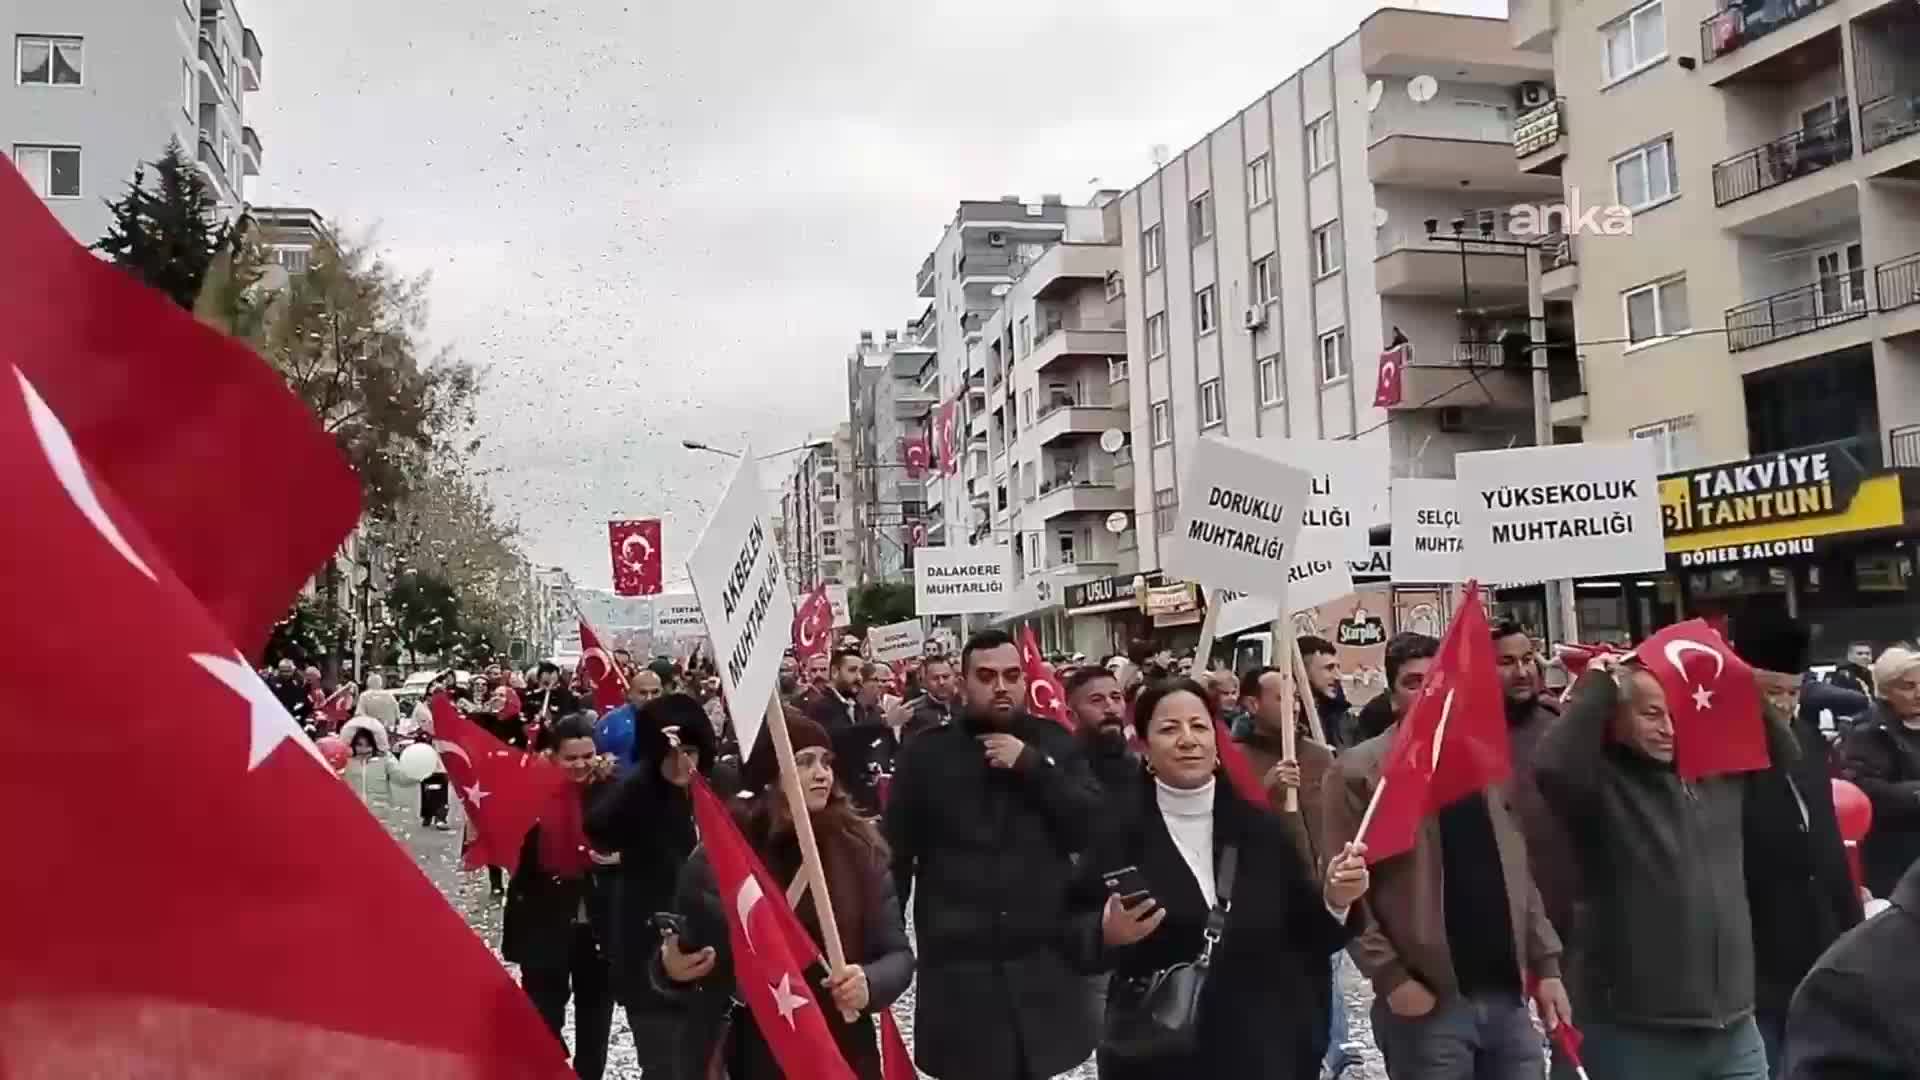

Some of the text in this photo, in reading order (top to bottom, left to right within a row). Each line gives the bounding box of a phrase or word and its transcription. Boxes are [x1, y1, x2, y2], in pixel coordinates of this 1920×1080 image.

[1307, 473, 1330, 495] Lİ
[1694, 453, 1830, 498] TAKVİYE
[1208, 487, 1284, 523] DORUKLU
[1481, 480, 1638, 509] YÜKSEKOLUK
[1697, 479, 1833, 527] TANTUNİ
[1188, 520, 1284, 561] MUHTARLIĞI
[1492, 512, 1633, 544] MUHTARLIĞI
[1743, 538, 1815, 560] SALONU
[722, 514, 764, 623] AKBELEN
[927, 564, 1001, 577] DALAKDERE
[926, 581, 1003, 595] MUHTARLIĞI
[728, 551, 780, 690] MUHTARLIĞI
